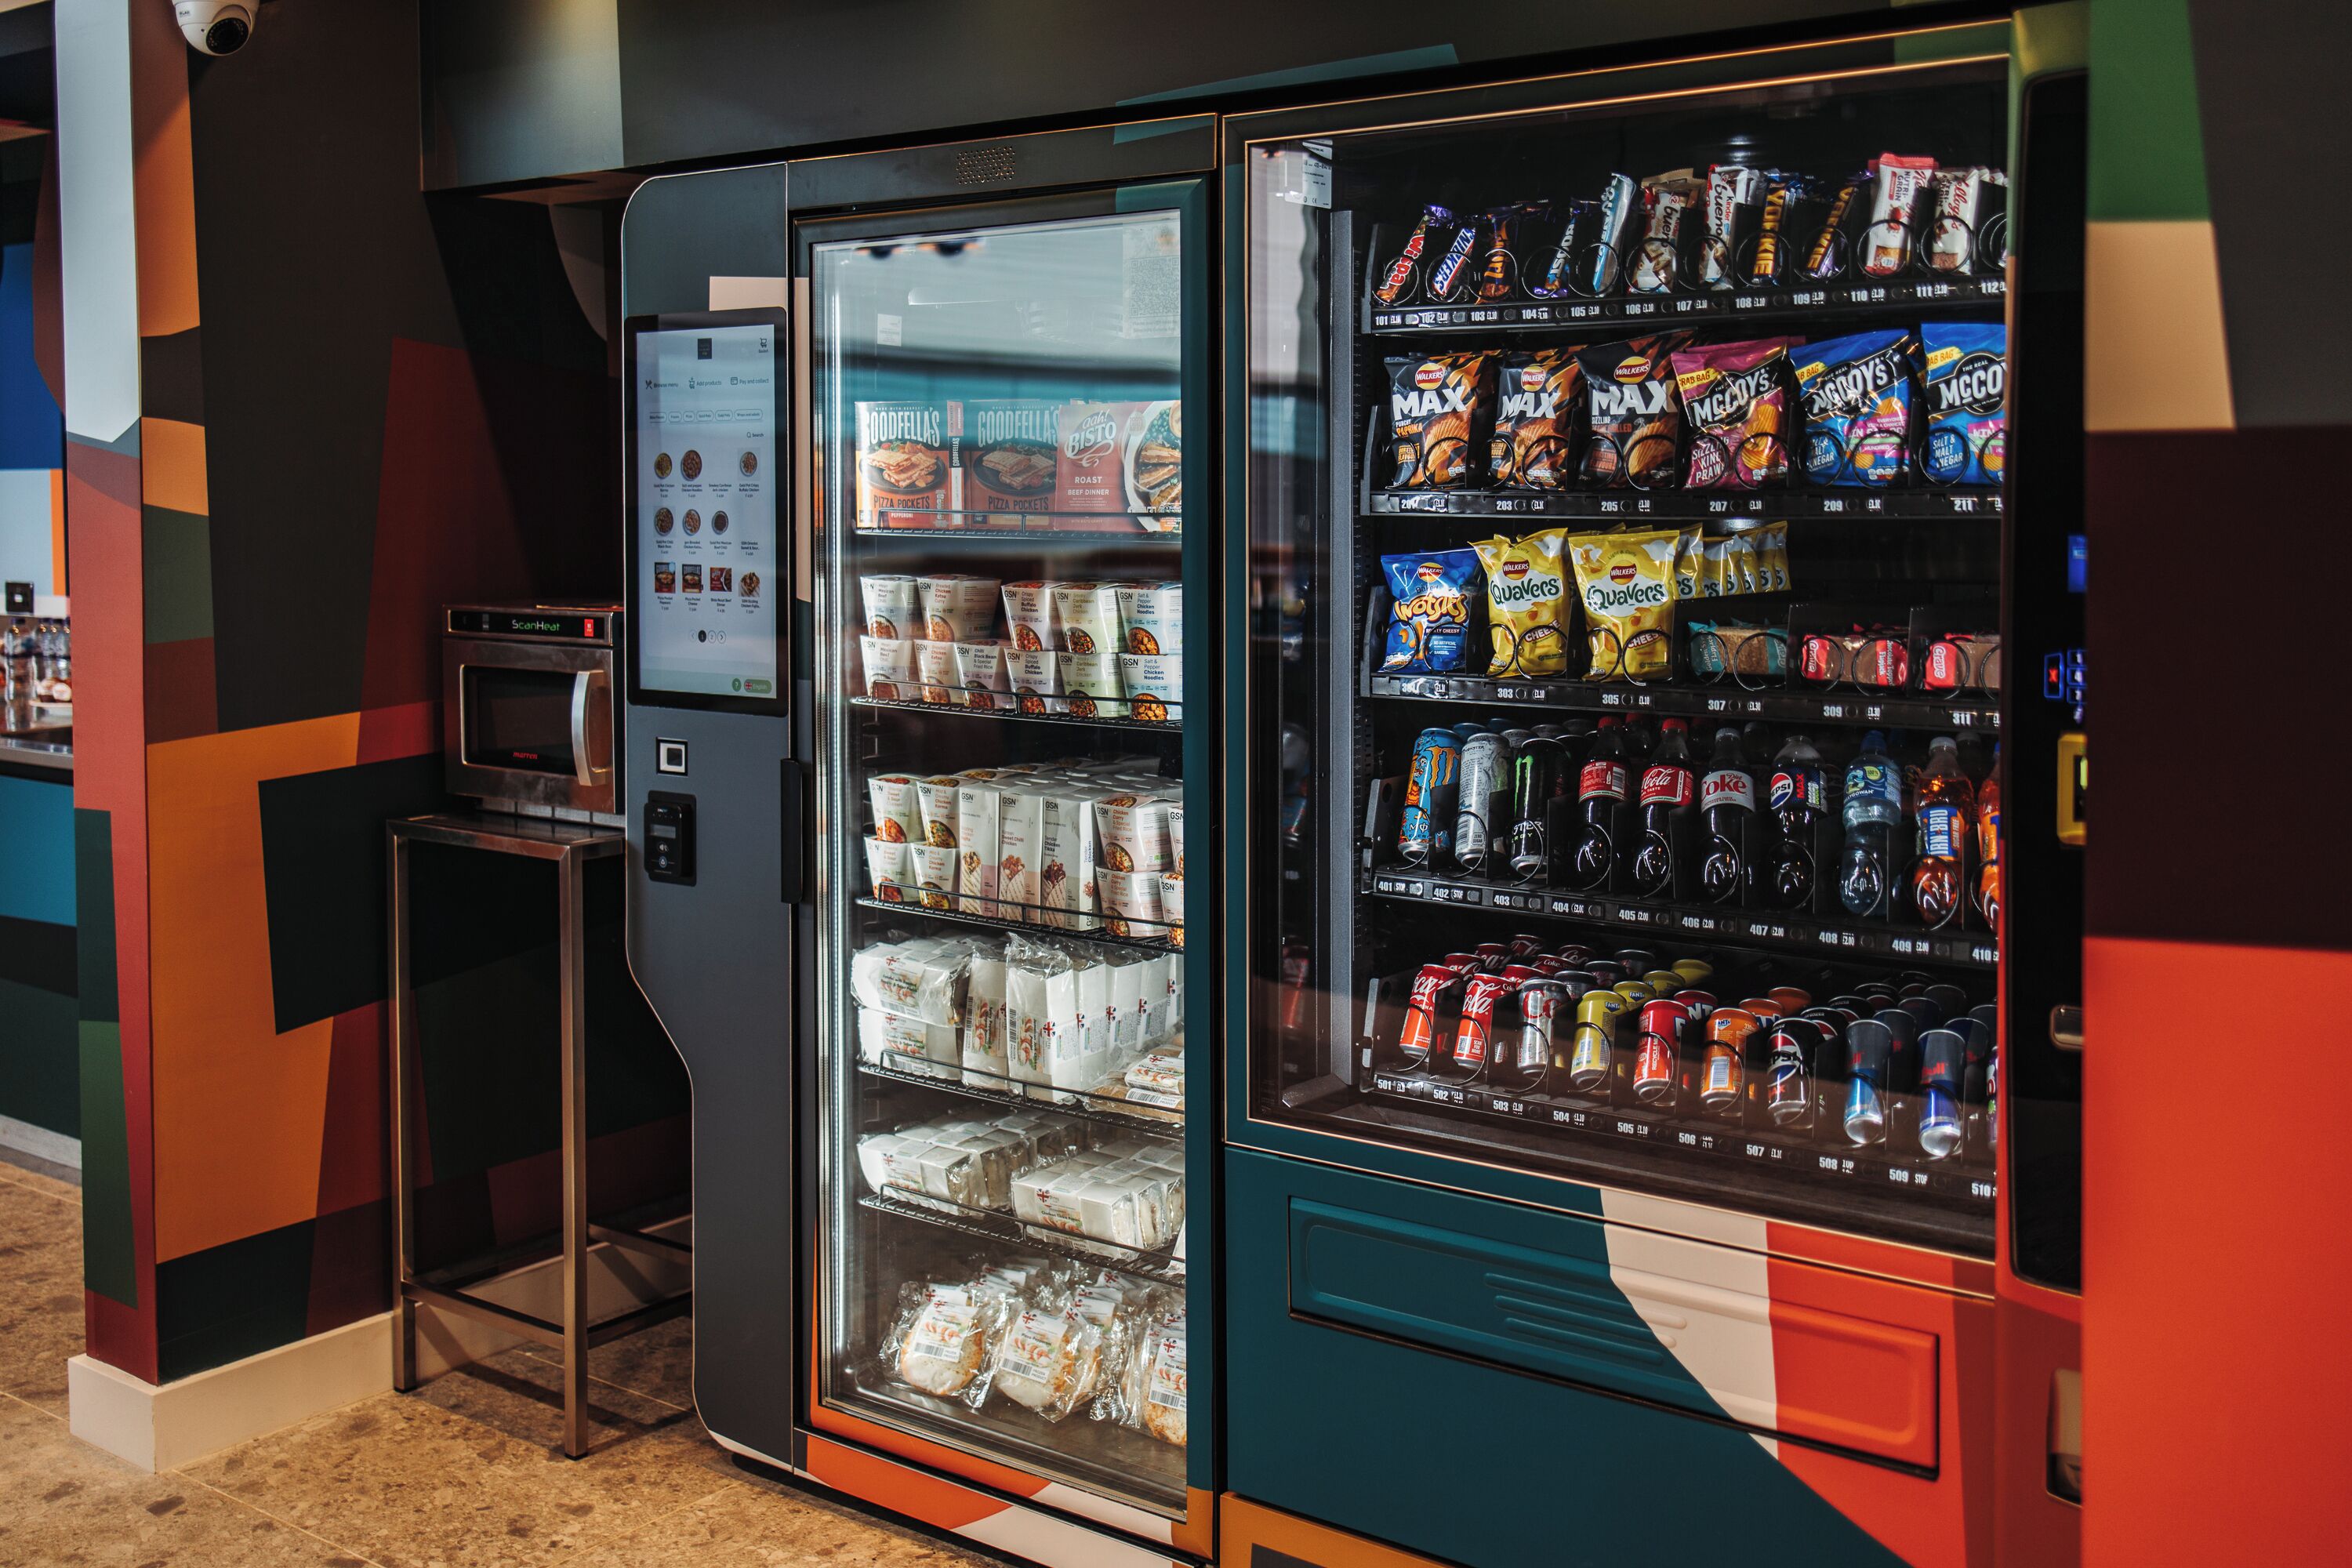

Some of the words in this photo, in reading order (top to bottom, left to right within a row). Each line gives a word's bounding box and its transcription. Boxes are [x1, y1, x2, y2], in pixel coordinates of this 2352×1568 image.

[1714, 184, 1728, 238] bueno
[1549, 223, 1575, 277] BOOST
[1916, 286, 1933, 297] 111
[1981, 282, 1999, 293] 112
[1793, 294, 1810, 305] 109
[1812, 292, 1824, 301] £1.10
[1851, 291, 1868, 302] 110
[1871, 289, 1884, 299] £1.10
[1676, 300, 1692, 310] 107
[1696, 299, 1708, 308] £1.10
[1736, 298, 1752, 308] 108
[1754, 297, 1766, 307] £1.10
[1570, 307, 1586, 317] 105
[1625, 304, 1641, 314] 106
[1643, 303, 1654, 312] £1.10
[1421, 314, 1436, 323] 102
[1471, 311, 1485, 321] 103
[1522, 309, 1537, 320] 104
[1375, 316, 1388, 325] 101
[1940, 349, 1954, 362] BAG
[1974, 360, 1988, 368] REAL
[1416, 372, 1443, 380] WALKERS
[1616, 365, 1649, 376] WALKERS
[1806, 364, 1820, 378] BAG
[1835, 366, 1848, 375] REAL
[1697, 371, 1711, 383] BAG
[1592, 380, 1678, 416] MAX
[1392, 387, 1468, 421] MAX
[1496, 392, 1562, 420] MAX
[1082, 409, 1110, 430] aah!
[1396, 419, 1412, 428] PUNCHY
[1592, 416, 1611, 425] SIZZLING
[1396, 423, 1423, 437] PAPRIKA
[1069, 421, 1116, 456] BISTO
[1933, 436, 1947, 450] SALT
[1935, 445, 1954, 458] MALT
[873, 495, 894, 509] PIZZA
[897, 495, 931, 510] POCKETS
[988, 495, 1010, 510] PIZZA
[1013, 496, 1049, 510] POCKETS
[1497, 501, 1512, 510] 203
[1601, 501, 1618, 512] 205
[1710, 501, 1727, 512] 207
[1824, 501, 1842, 512] 209
[1954, 500, 1972, 510] 211
[1607, 550, 1618, 560] Light
[1502, 563, 1529, 572] WALKERS
[1610, 568, 1636, 576] WALKERS
[1004, 590, 1017, 599] GSN
[1057, 592, 1069, 601] GSN
[512, 619, 560, 632] ScanHeat
[1524, 619, 1562, 643] CHEESE
[956, 647, 970, 655] GSN
[1708, 634, 1719, 662] Flapjack
[1007, 652, 1021, 662] GSN
[1060, 655, 1073, 663] GSN
[1703, 649, 1713, 672] Golden
[1808, 640, 1820, 673] Crave
[1933, 645, 1947, 679] Crave
[1497, 688, 1514, 698] 303
[1534, 688, 1545, 699] £1.10
[1602, 695, 1619, 705] 305
[1708, 700, 1726, 710] 307
[1823, 706, 1842, 717] 309
[1952, 713, 1971, 725] 311
[513, 750, 538, 760] marren
[1796, 773, 1806, 799] MAX
[961, 792, 974, 801] GSN
[1002, 797, 1016, 806] GSN
[1045, 801, 1058, 811] GSN
[1096, 807, 1109, 816] GSN
[1929, 809, 1949, 855] IRN-BRU
[1097, 871, 1108, 880] GSN
[1161, 882, 1174, 891] GSN
[1378, 881, 1392, 891] 401
[1395, 881, 1406, 891] STOP
[1433, 887, 1450, 898] 402
[1453, 888, 1464, 898] STOP
[1494, 895, 1510, 906] 403
[1552, 902, 1570, 913] 404
[1618, 909, 1635, 920] 405
[1638, 911, 1649, 921] £2.00
[1682, 916, 1700, 928] 406
[1702, 919, 1715, 929] £2.00
[1749, 924, 1768, 936] 407
[1772, 927, 1784, 938] £2.00
[1819, 931, 1838, 943] 408
[1842, 934, 1855, 946] £2.00
[1892, 940, 1911, 953] 409
[1916, 942, 1929, 953] £2.00
[1973, 949, 1992, 961] 410
[1543, 959, 1561, 967] Coke
[1377, 1080, 1392, 1091] 501
[1433, 1089, 1449, 1102] 502
[1493, 1099, 1508, 1112] 503
[1512, 1102, 1523, 1112] £1.10
[1553, 1110, 1570, 1123] 504
[1617, 1122, 1634, 1134] 505
[1679, 1132, 1696, 1145] 506
[1746, 1144, 1765, 1157] 507
[1819, 1156, 1838, 1170] 508
[1889, 1170, 1908, 1182] 509
[1915, 1174, 1928, 1185] STOP
[1971, 1183, 1991, 1197] 510
